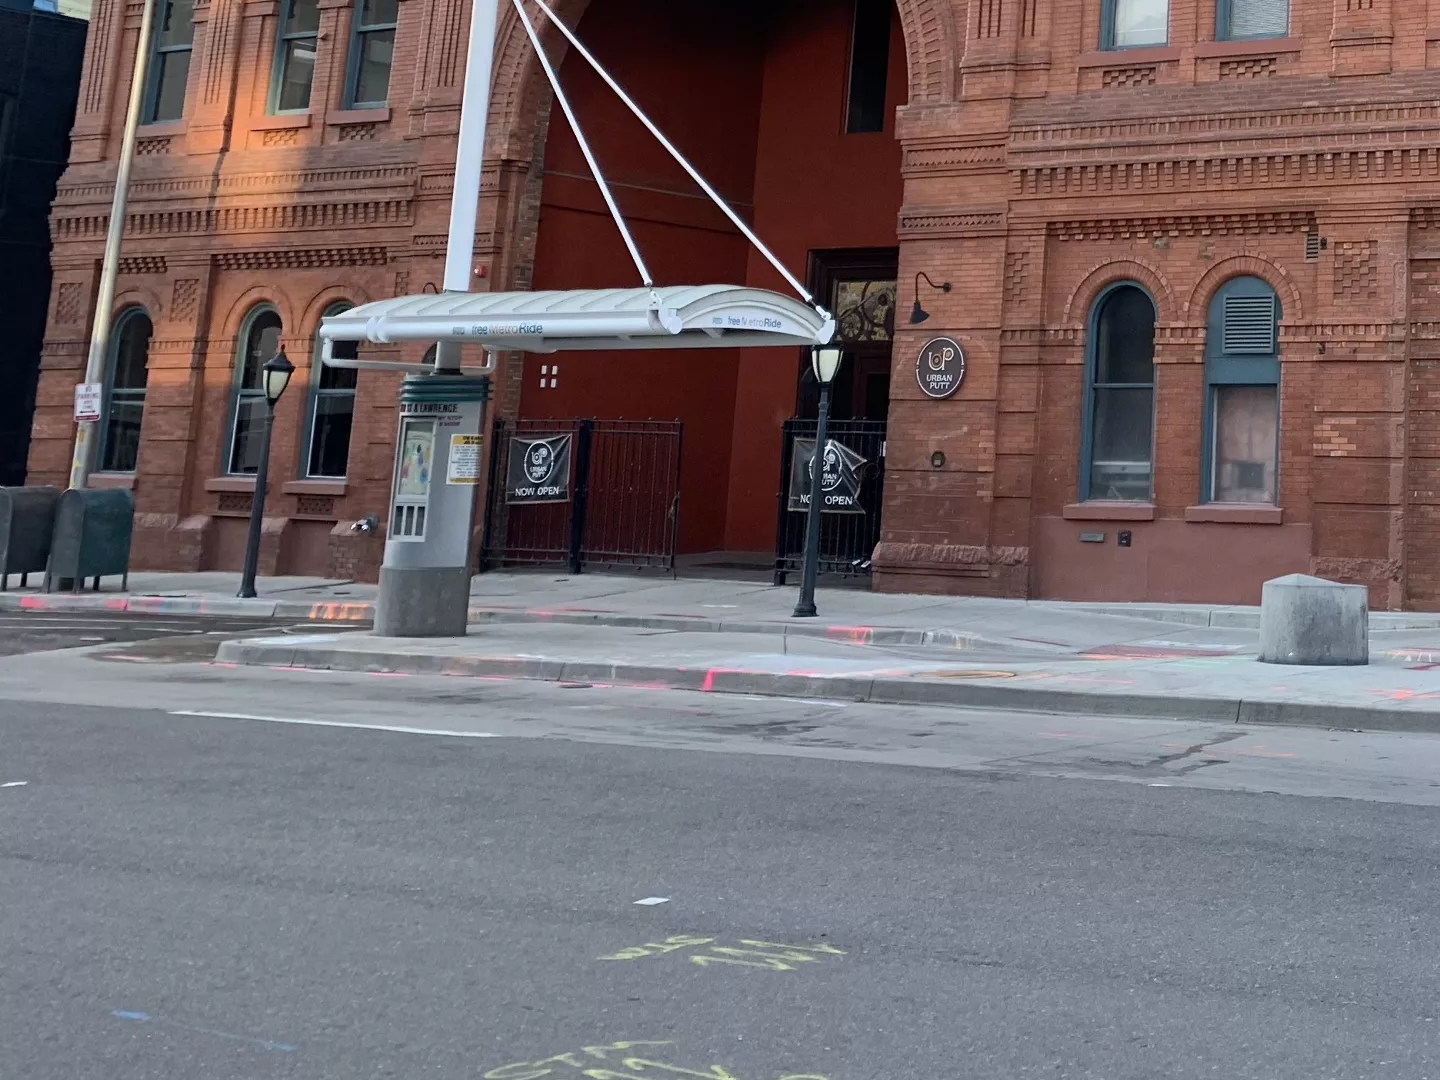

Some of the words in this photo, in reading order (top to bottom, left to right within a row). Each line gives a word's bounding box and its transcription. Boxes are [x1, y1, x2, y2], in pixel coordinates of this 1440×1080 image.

[926, 374, 953, 382] URBAN
[929, 382, 951, 390] PUTT
[515, 488, 535, 496] NOW
[537, 486, 560, 495] OPEN
[824, 495, 853, 505] OPEN
